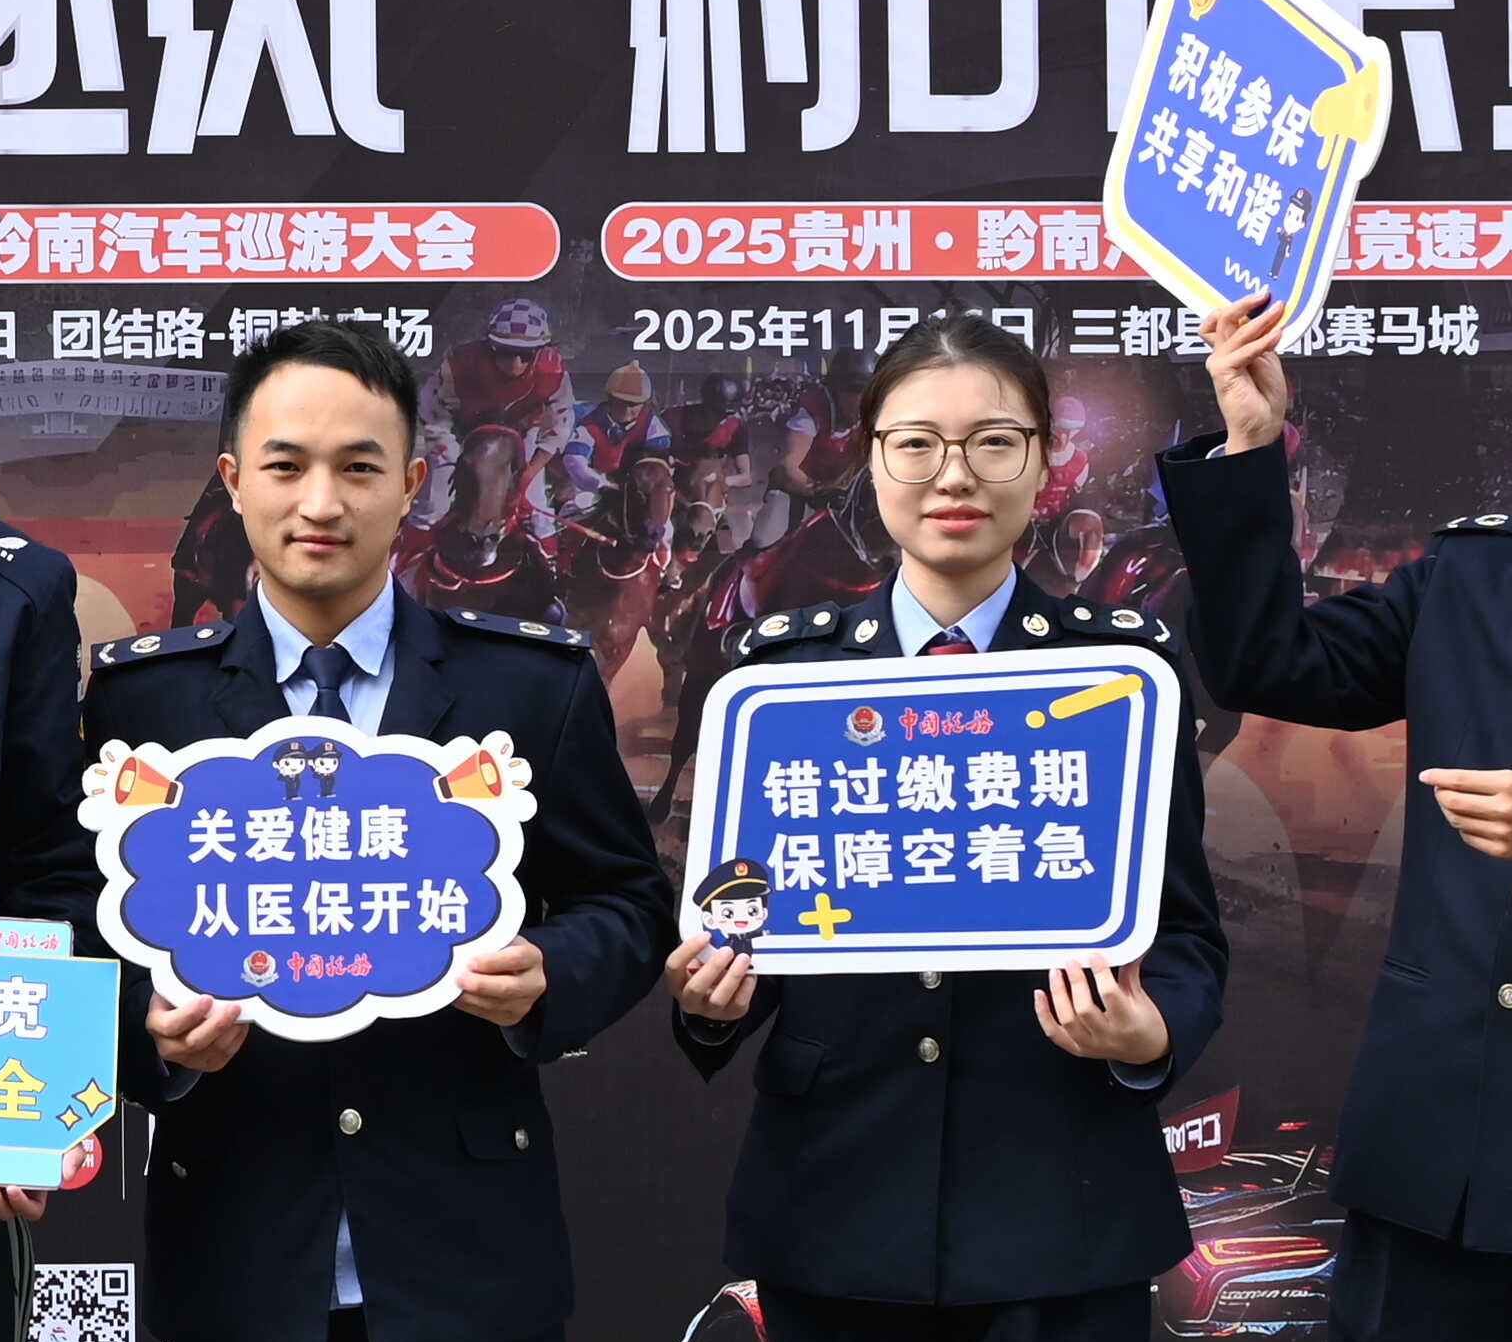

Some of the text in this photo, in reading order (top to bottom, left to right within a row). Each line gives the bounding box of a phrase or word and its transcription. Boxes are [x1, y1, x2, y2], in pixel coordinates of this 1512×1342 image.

[1167, 32, 1312, 167] 积极参保
[1138, 106, 1282, 246] 共享和谐
[632, 306, 1035, 356] 2025年11月日
[761, 748, 1090, 820] 错过缴费期
[186, 804, 411, 865] 关爱健康
[766, 821, 1097, 893] 保障空着急
[187, 877, 470, 939] 从医保开始
